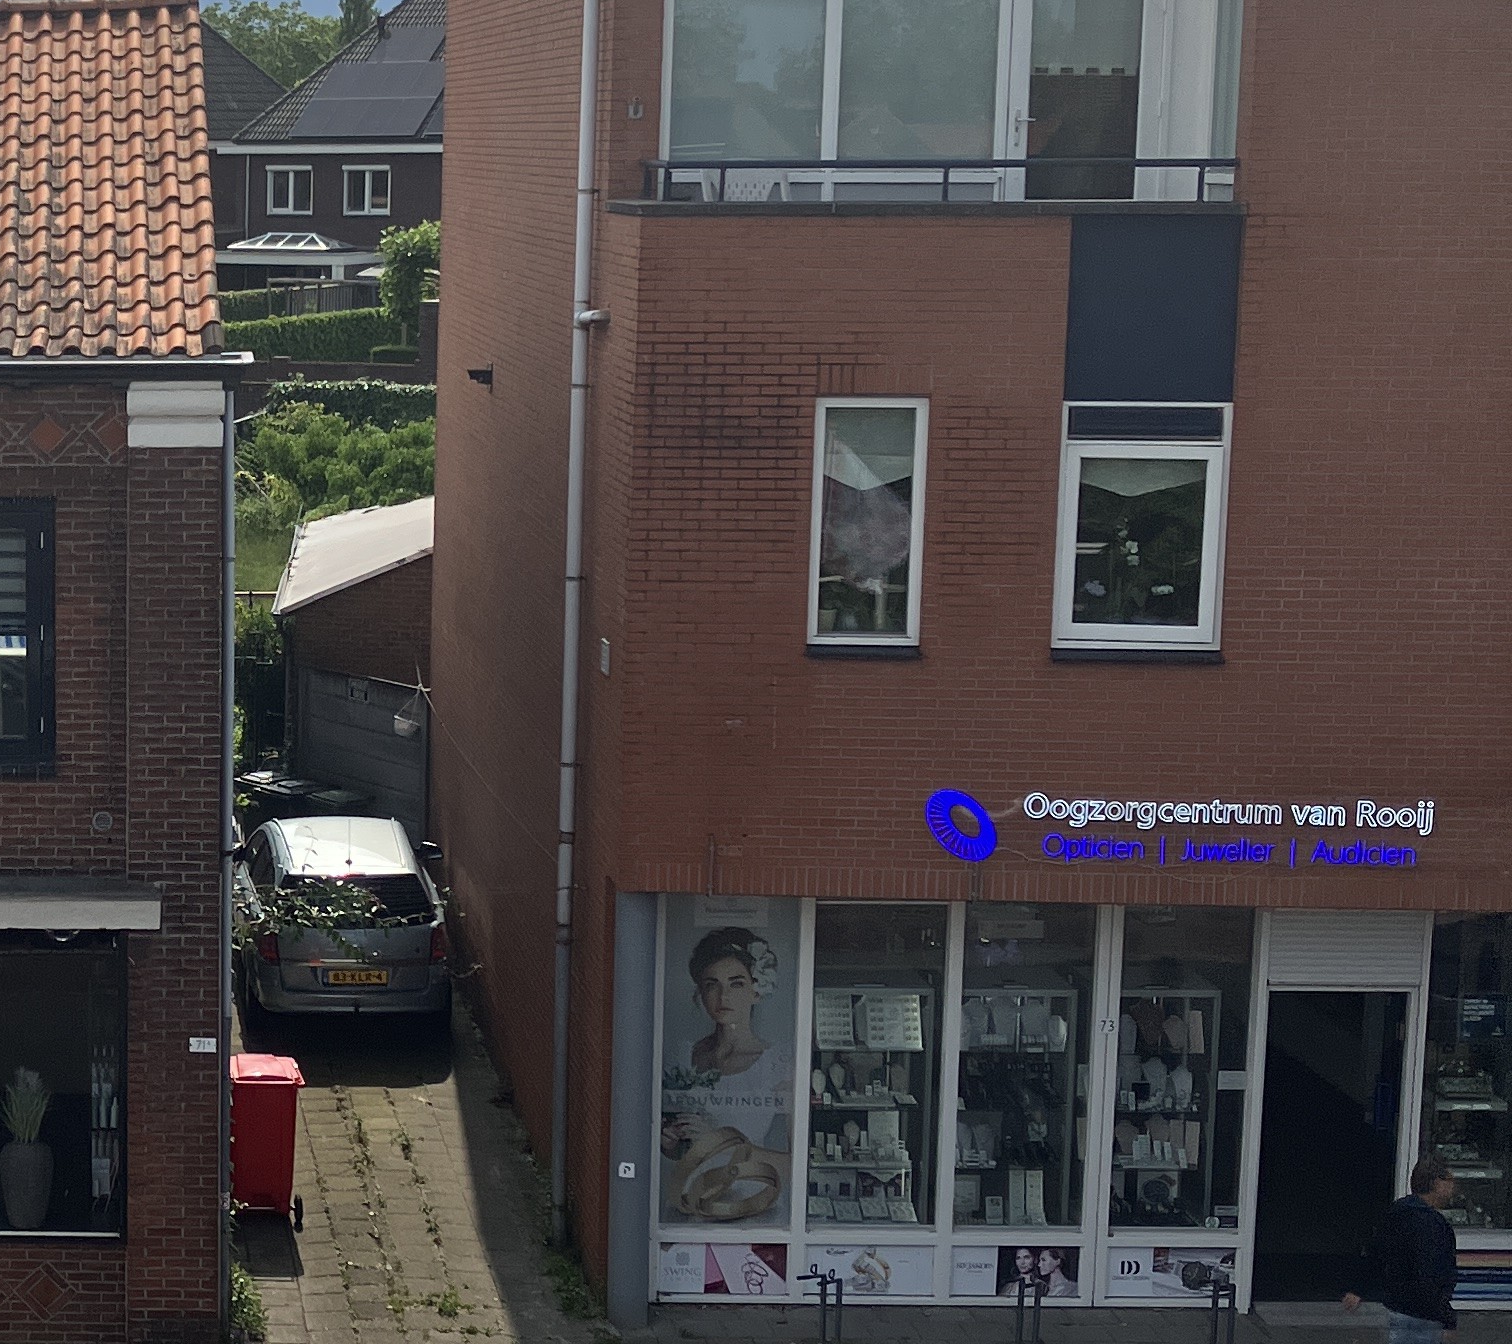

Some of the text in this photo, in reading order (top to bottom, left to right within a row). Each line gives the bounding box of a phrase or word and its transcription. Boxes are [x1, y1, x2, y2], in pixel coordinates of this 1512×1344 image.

[1023, 791, 1435, 836] Oogzorgcentrum van Rooij
[1041, 832, 1417, 867] Opticien Juwelier Audicien
[1100, 1019, 1115, 1032] 73
